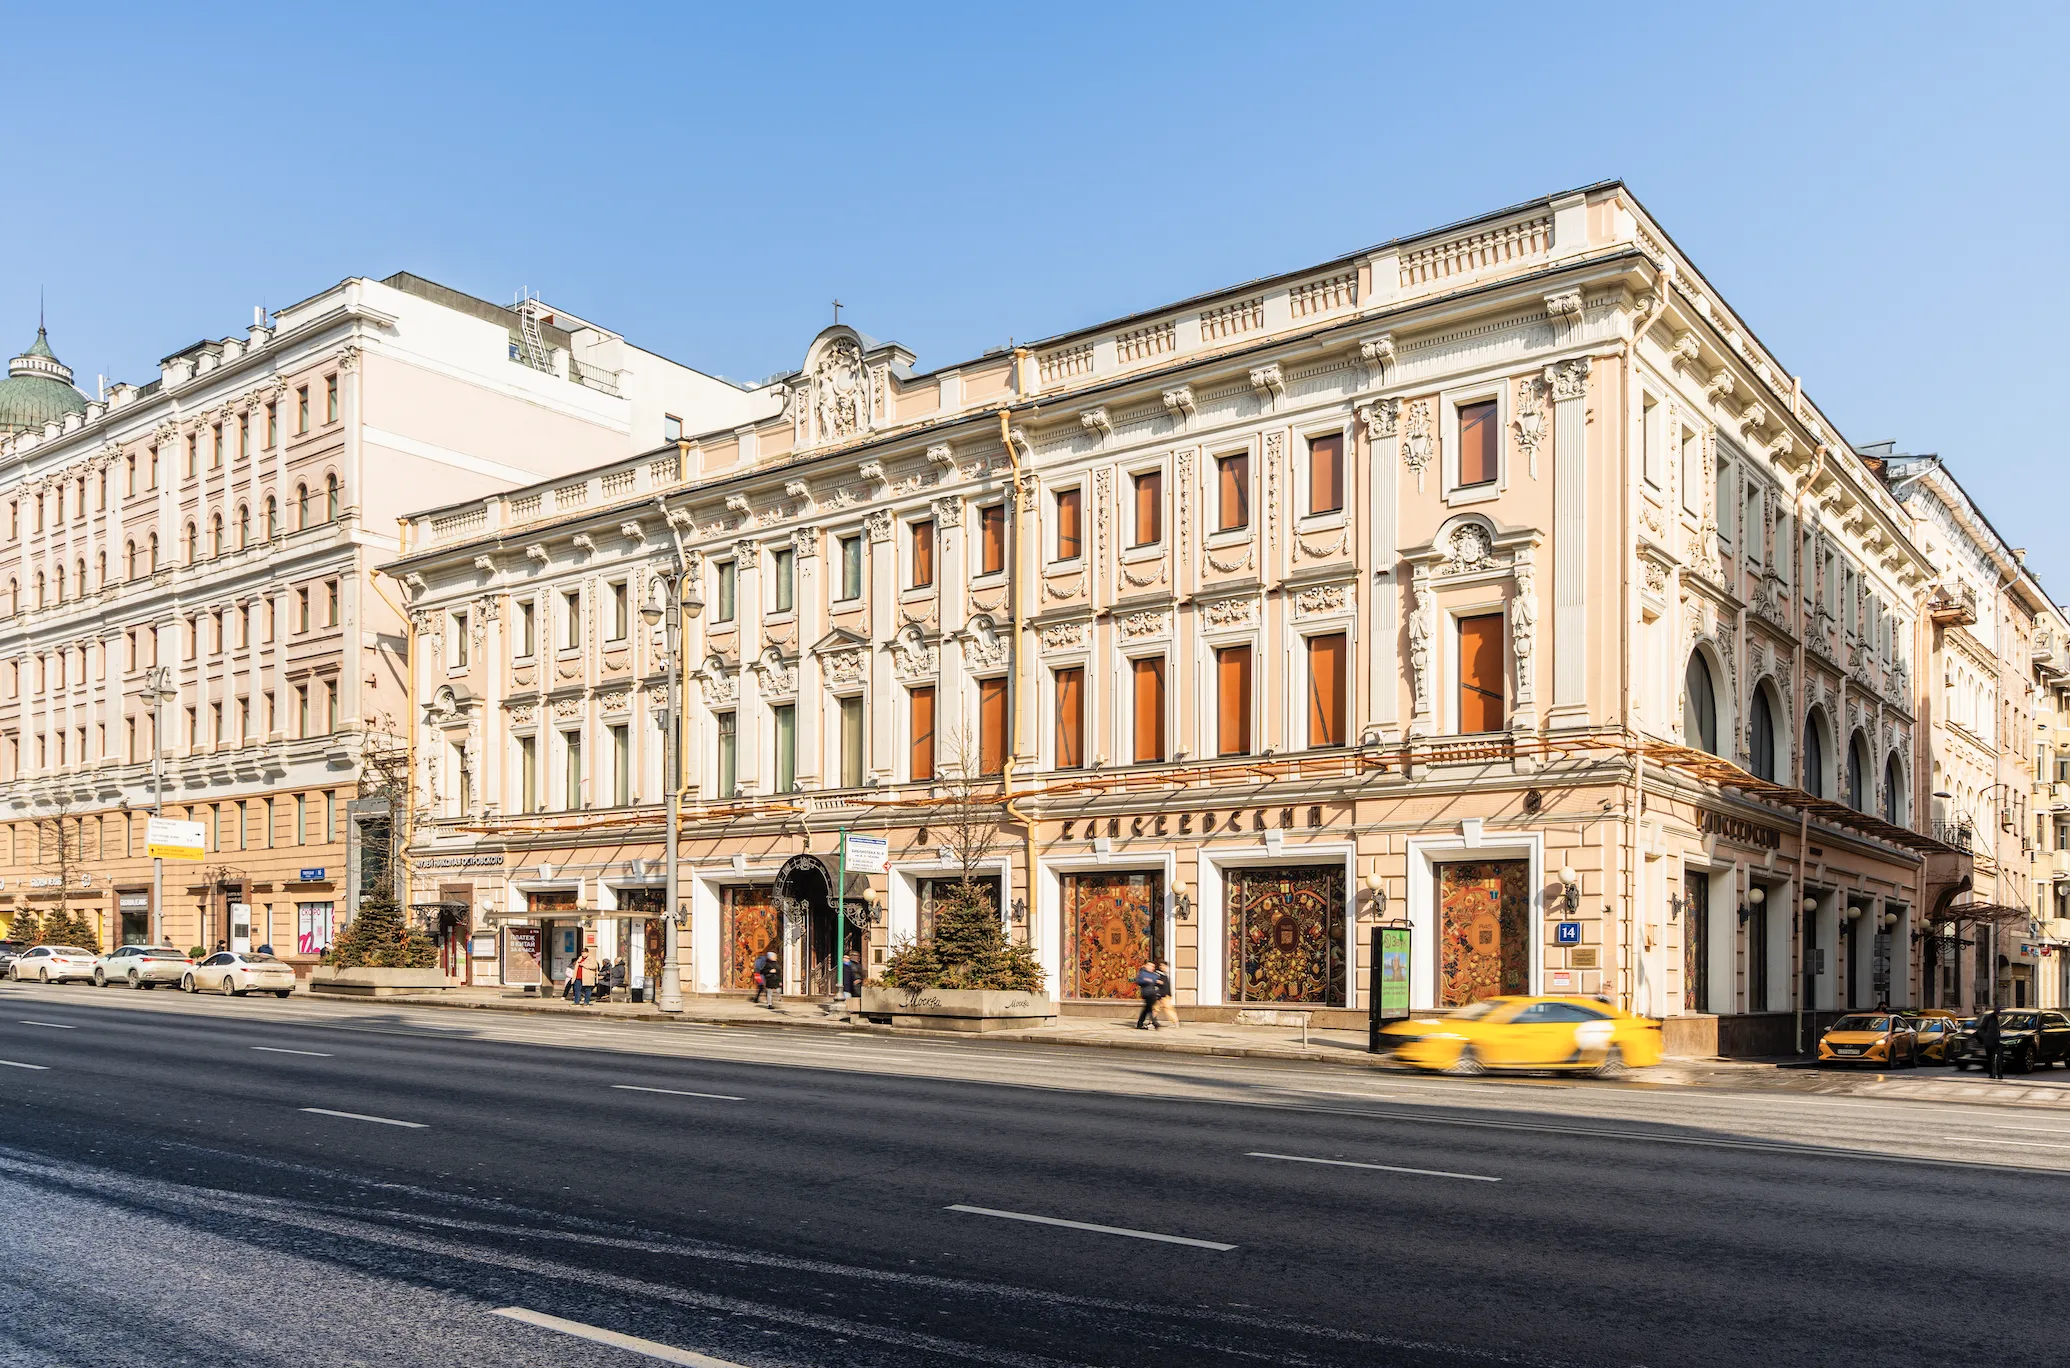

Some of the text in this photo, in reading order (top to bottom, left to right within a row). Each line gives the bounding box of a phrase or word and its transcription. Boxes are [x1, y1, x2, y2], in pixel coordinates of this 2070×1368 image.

[1061, 805, 1322, 840] ЕЛИСЕЕВСКИЙ
[415, 855, 504, 869] МУЗЕЙ НИКОЛАЯ ОСТРОВСКОГО
[301, 908, 321, 916] СКОРО
[1562, 926, 1576, 939] 14
[514, 940, 536, 948] КИТАЙ
[898, 992, 942, 1009] Москва
